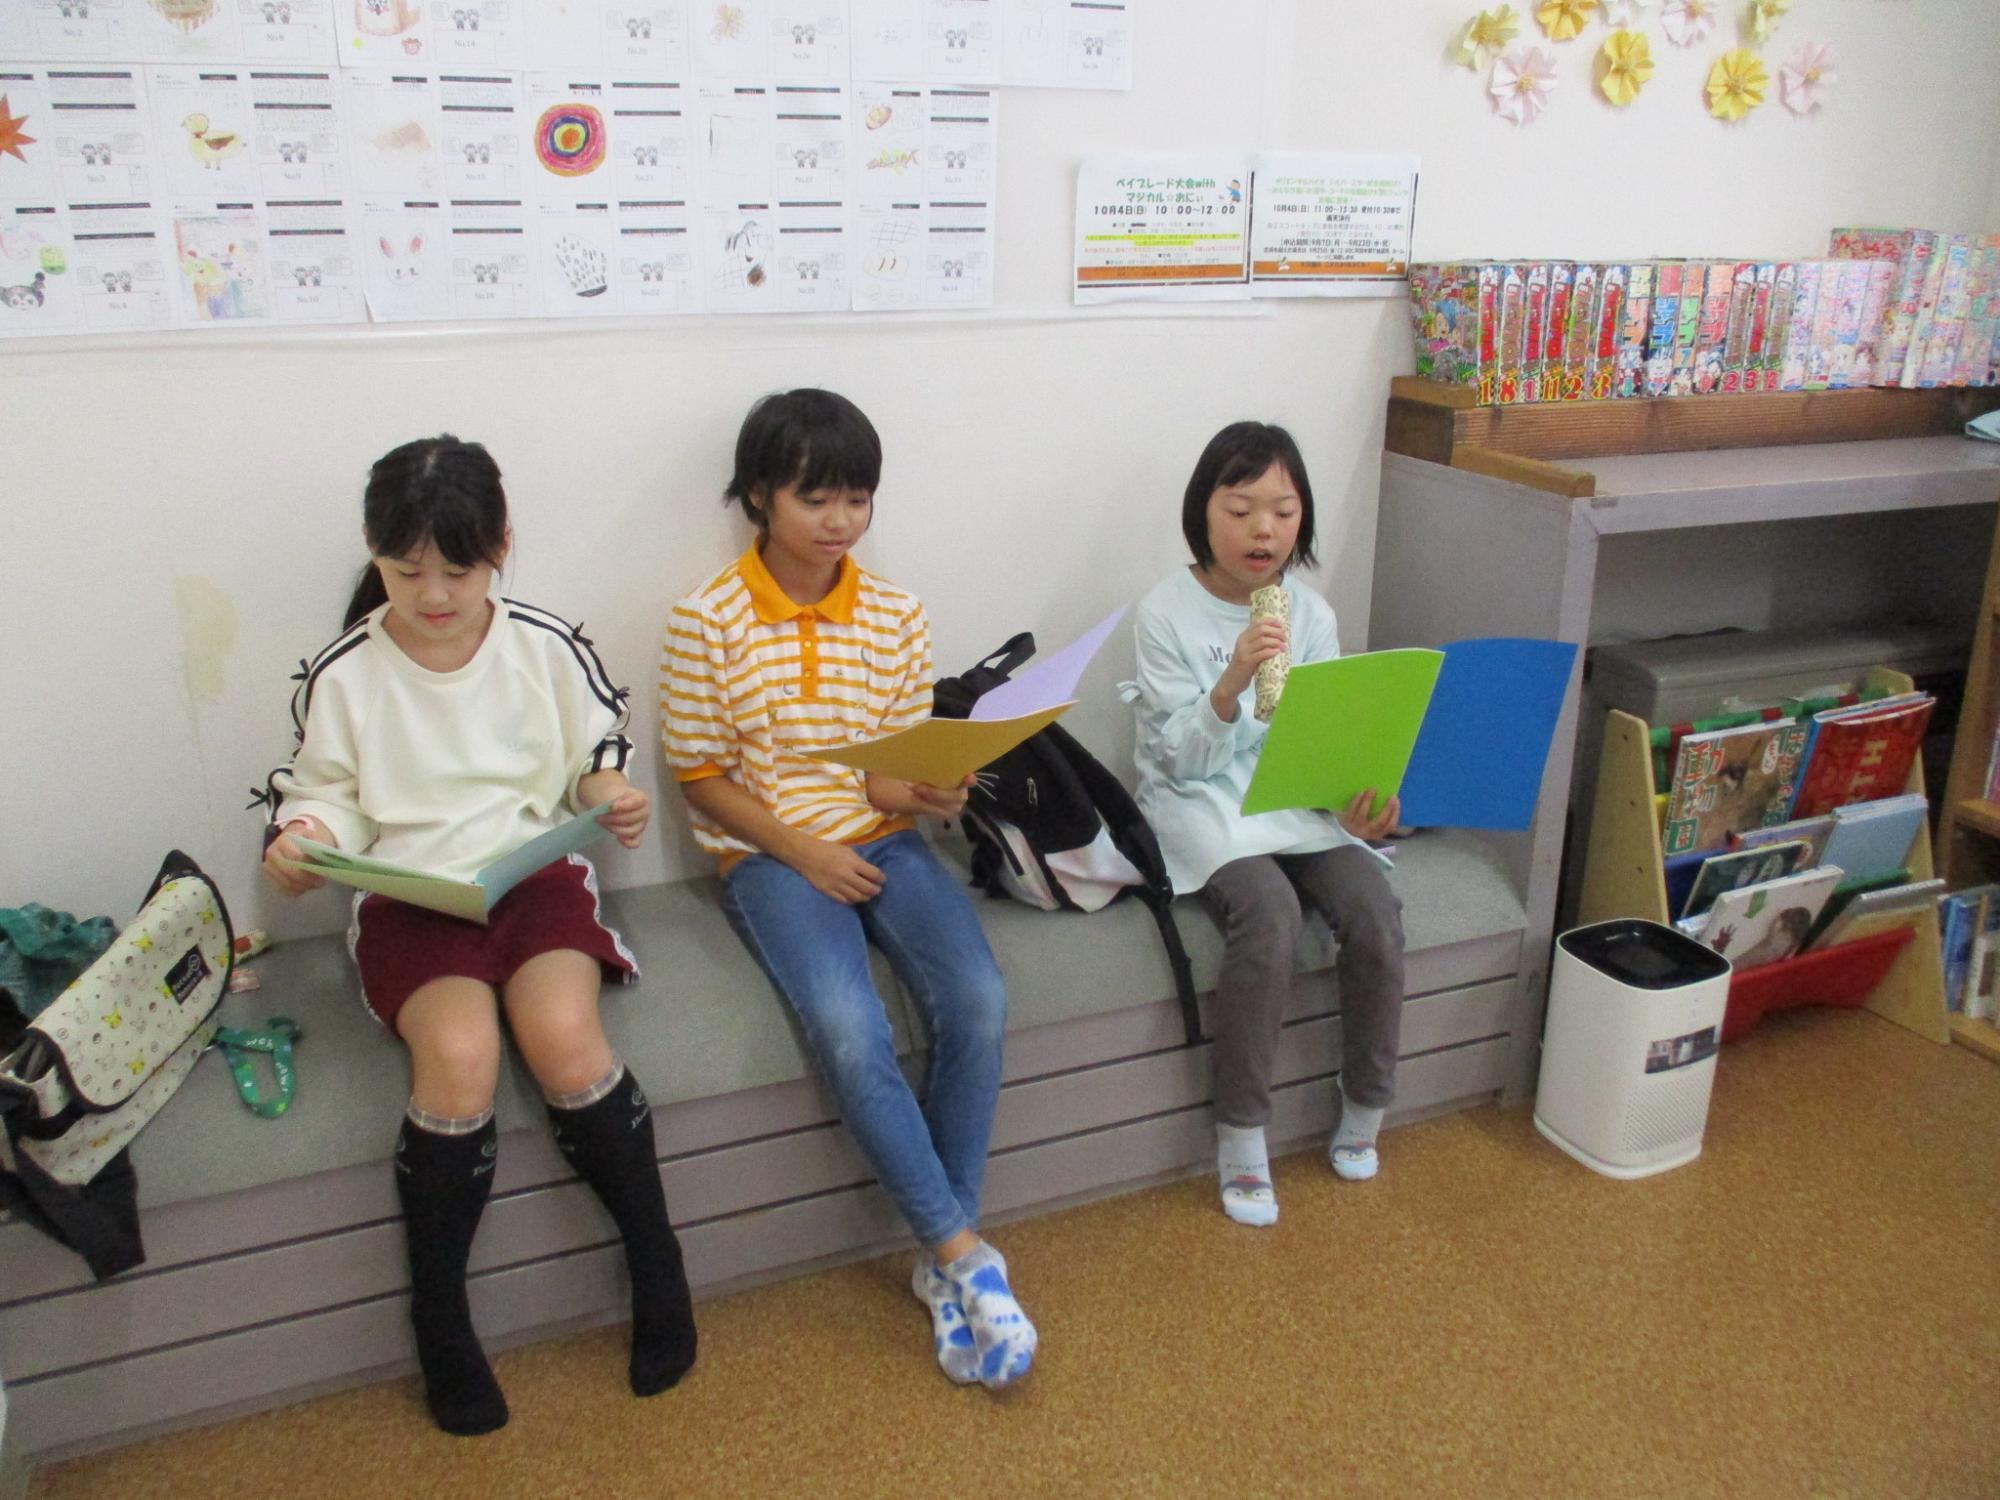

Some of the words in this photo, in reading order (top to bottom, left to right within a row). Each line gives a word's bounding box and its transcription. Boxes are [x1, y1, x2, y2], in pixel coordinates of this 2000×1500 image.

[1480, 377, 1492, 405] 1
[1562, 374, 1583, 400] 2
[1723, 371, 1739, 392] 2
